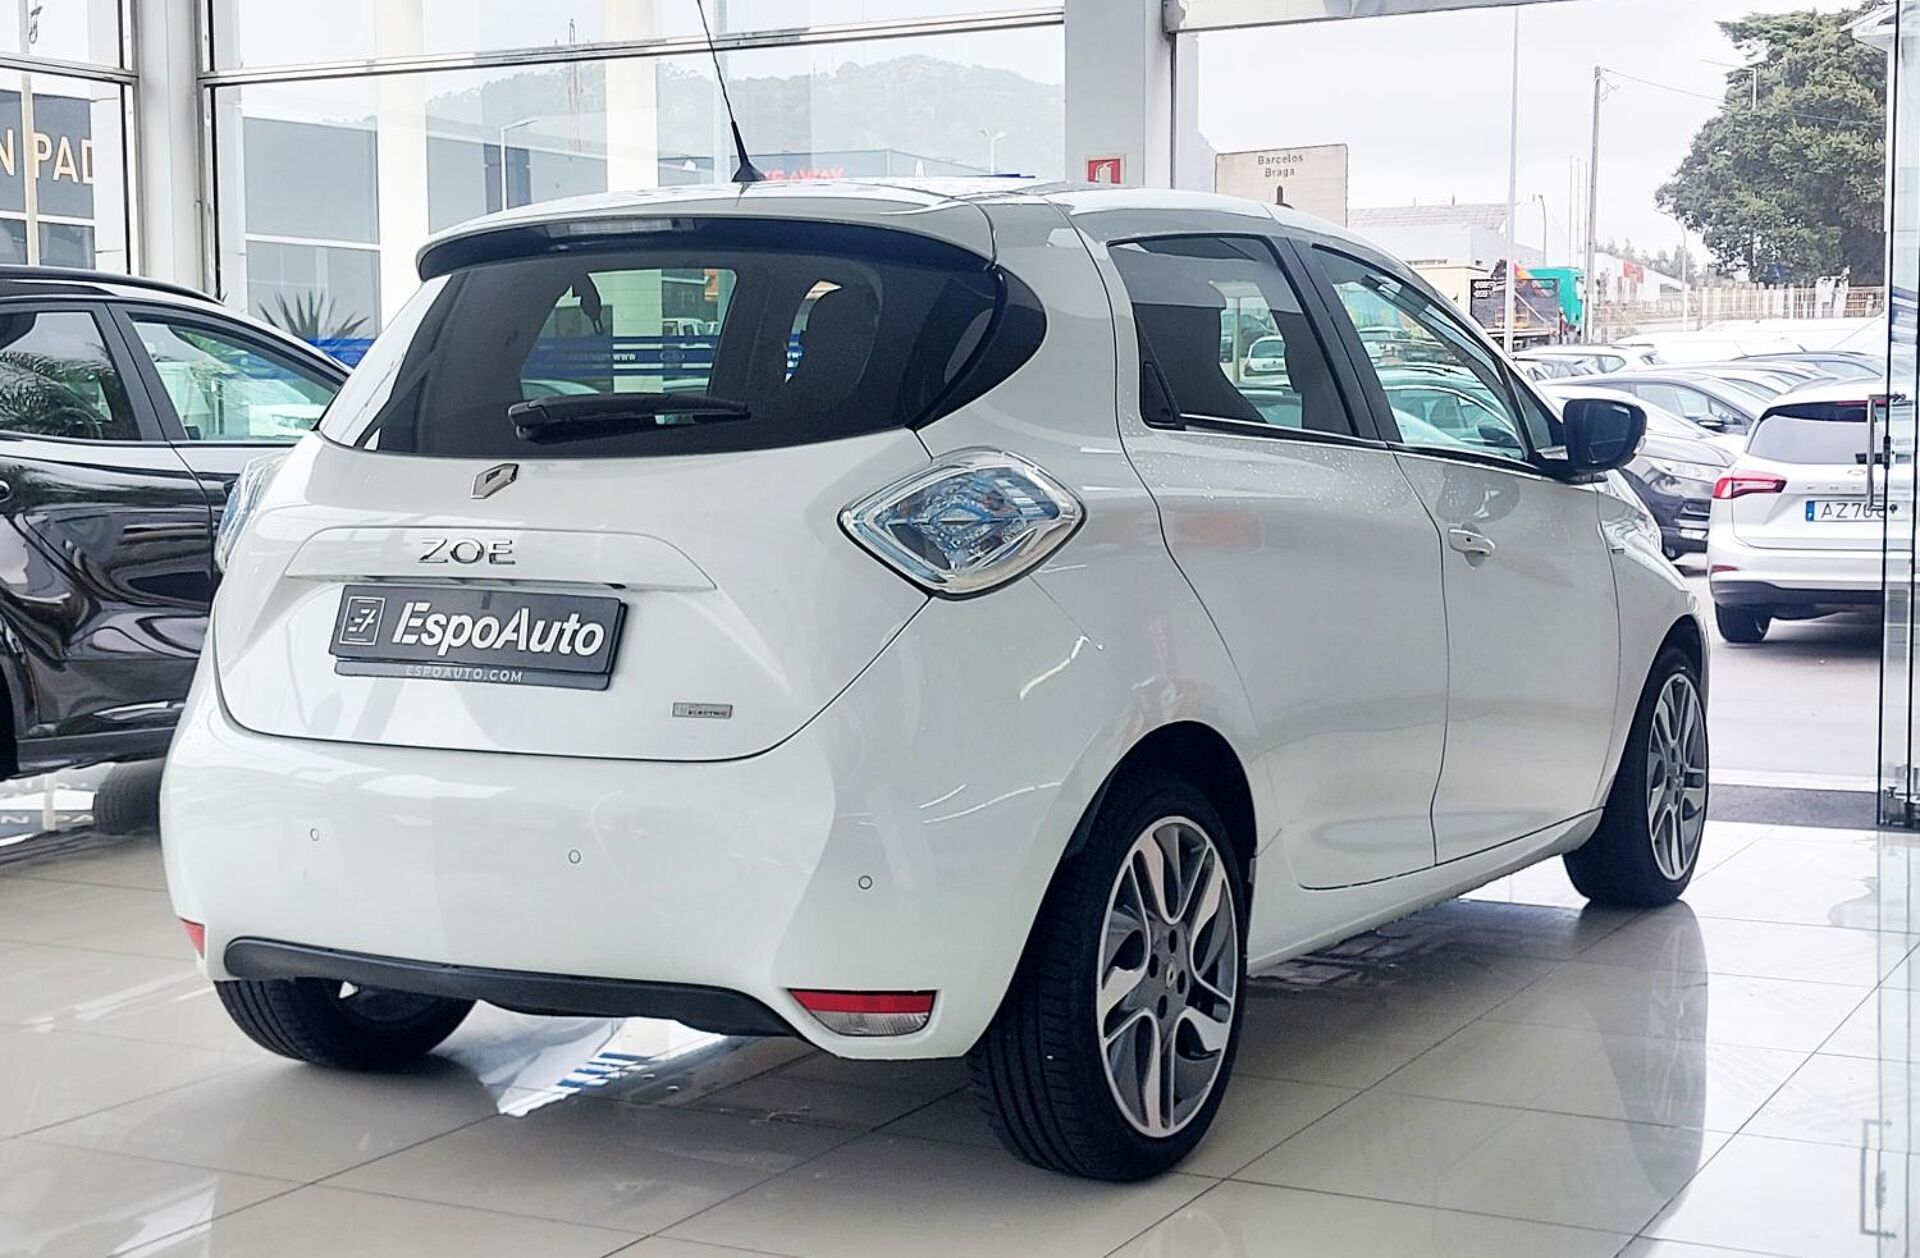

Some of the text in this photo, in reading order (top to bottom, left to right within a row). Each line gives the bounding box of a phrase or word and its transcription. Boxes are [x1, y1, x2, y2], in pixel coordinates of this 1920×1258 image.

[1257, 154, 1304, 165] Barcelos
[1264, 167, 1295, 178] Braga
[418, 537, 516, 565] ZOE
[392, 601, 605, 656] EspoAuto
[405, 666, 522, 682] ESPOAUTO.COM
